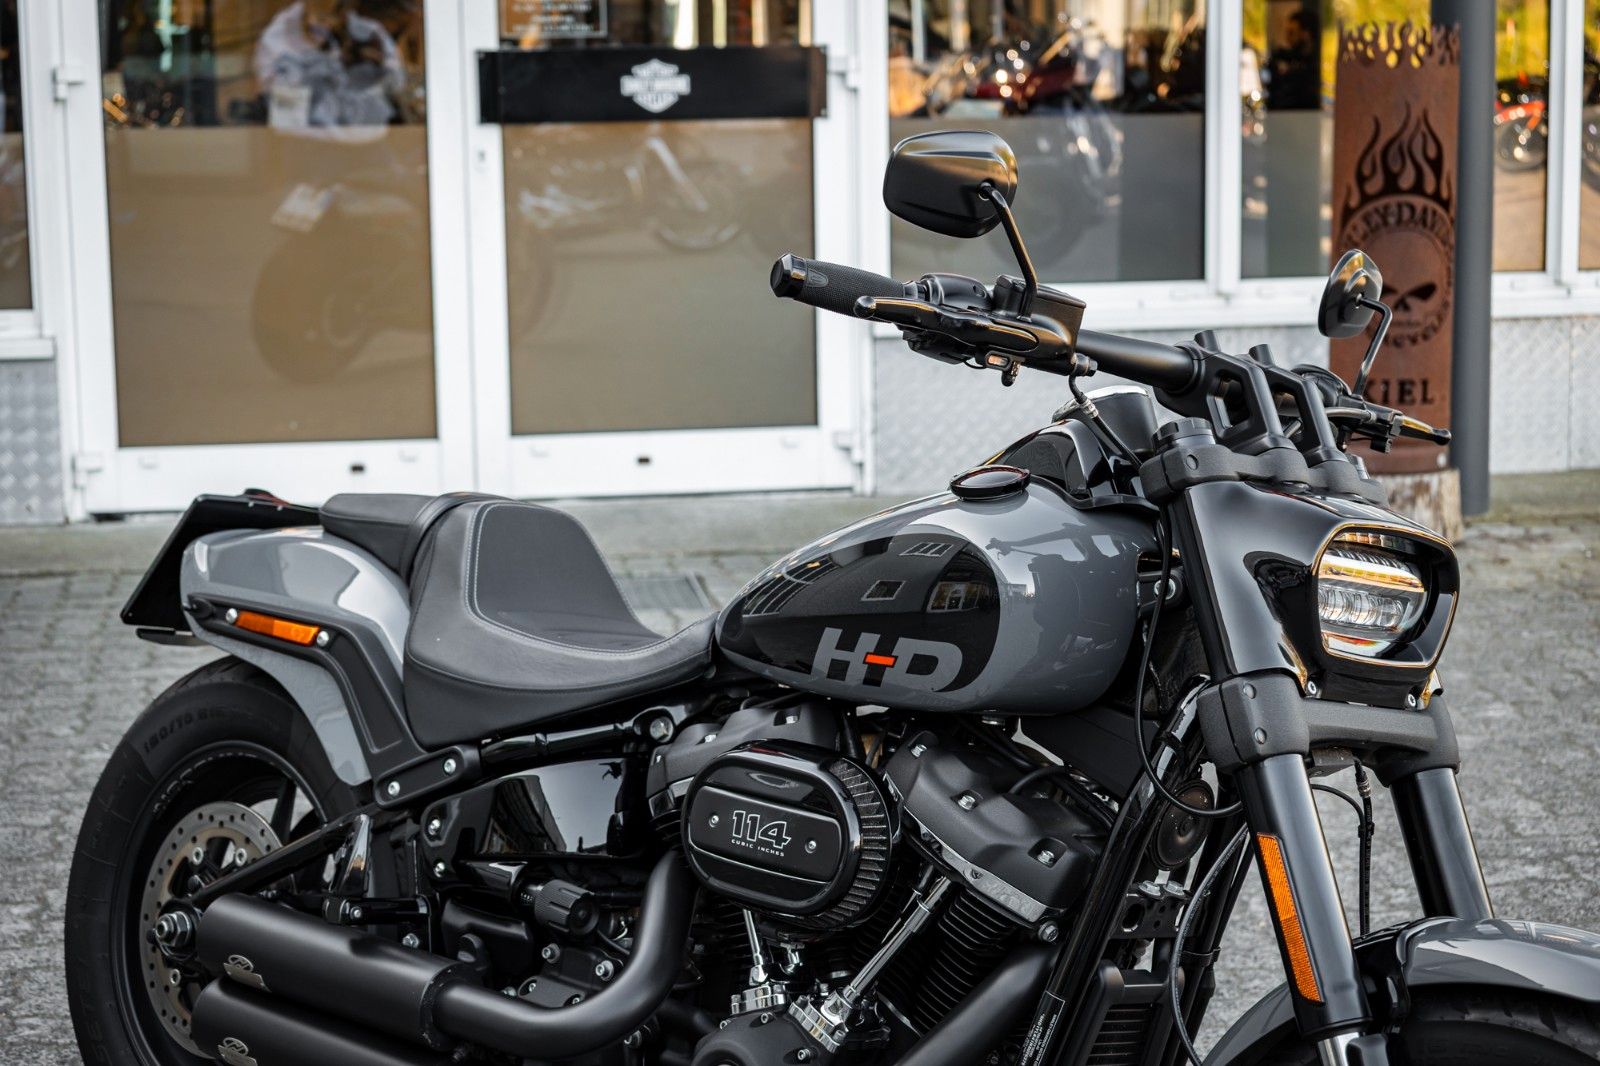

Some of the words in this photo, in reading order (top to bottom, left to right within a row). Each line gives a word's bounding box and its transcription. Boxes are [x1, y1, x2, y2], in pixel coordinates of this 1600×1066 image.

[810, 627, 963, 692] H-D
[731, 838, 754, 849] CUBIC
[757, 846, 785, 857] INCHES
[732, 810, 791, 849] 114
